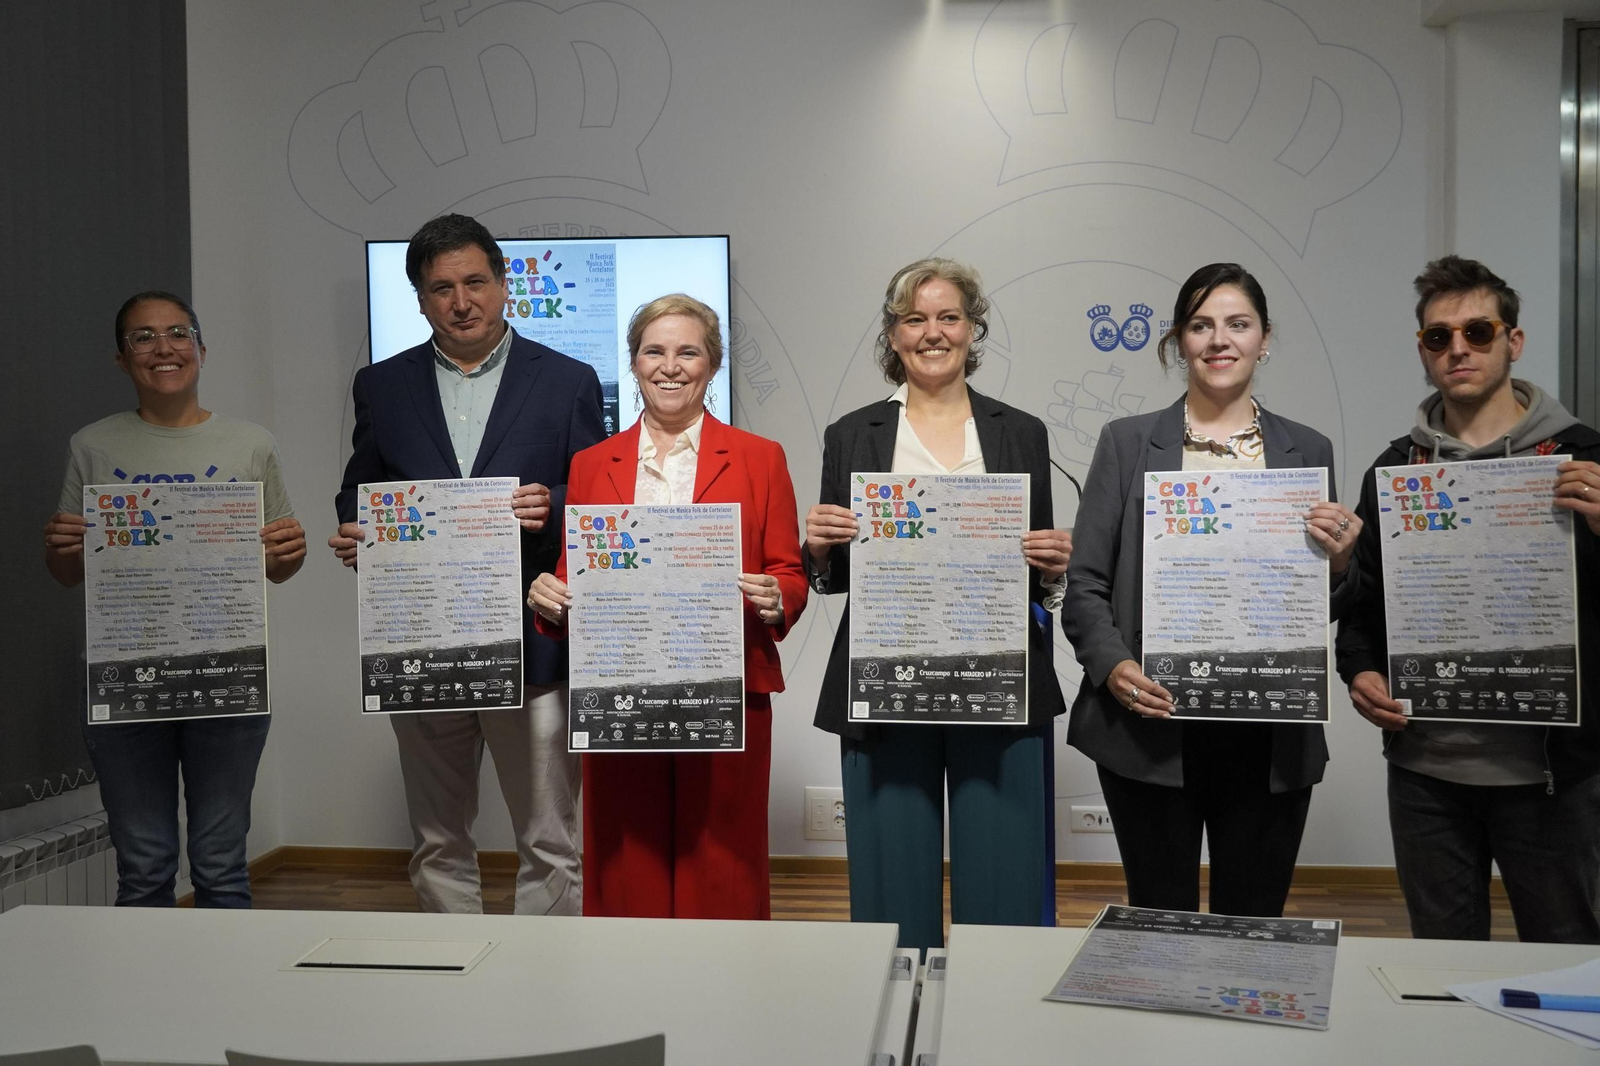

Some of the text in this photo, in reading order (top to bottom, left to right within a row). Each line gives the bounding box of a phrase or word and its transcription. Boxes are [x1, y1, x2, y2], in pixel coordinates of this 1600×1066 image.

[866, 483, 904, 500] COR
[1160, 480, 1198, 497] COR
[1393, 474, 1434, 493] COR
[99, 493, 138, 510] COR
[370, 491, 405, 507] COR
[1161, 498, 1216, 515] TELA
[1395, 492, 1453, 511] TELA
[372, 507, 422, 524] TELA
[867, 501, 921, 518] TELA
[100, 510, 156, 527] TELA
[580, 514, 618, 532] COR
[582, 532, 635, 549] TELA
[160, 668, 192, 676] Cruzcampo
[1215, 665, 1248, 673] Cruzcampo
[638, 697, 669, 705] Cruzcampo
